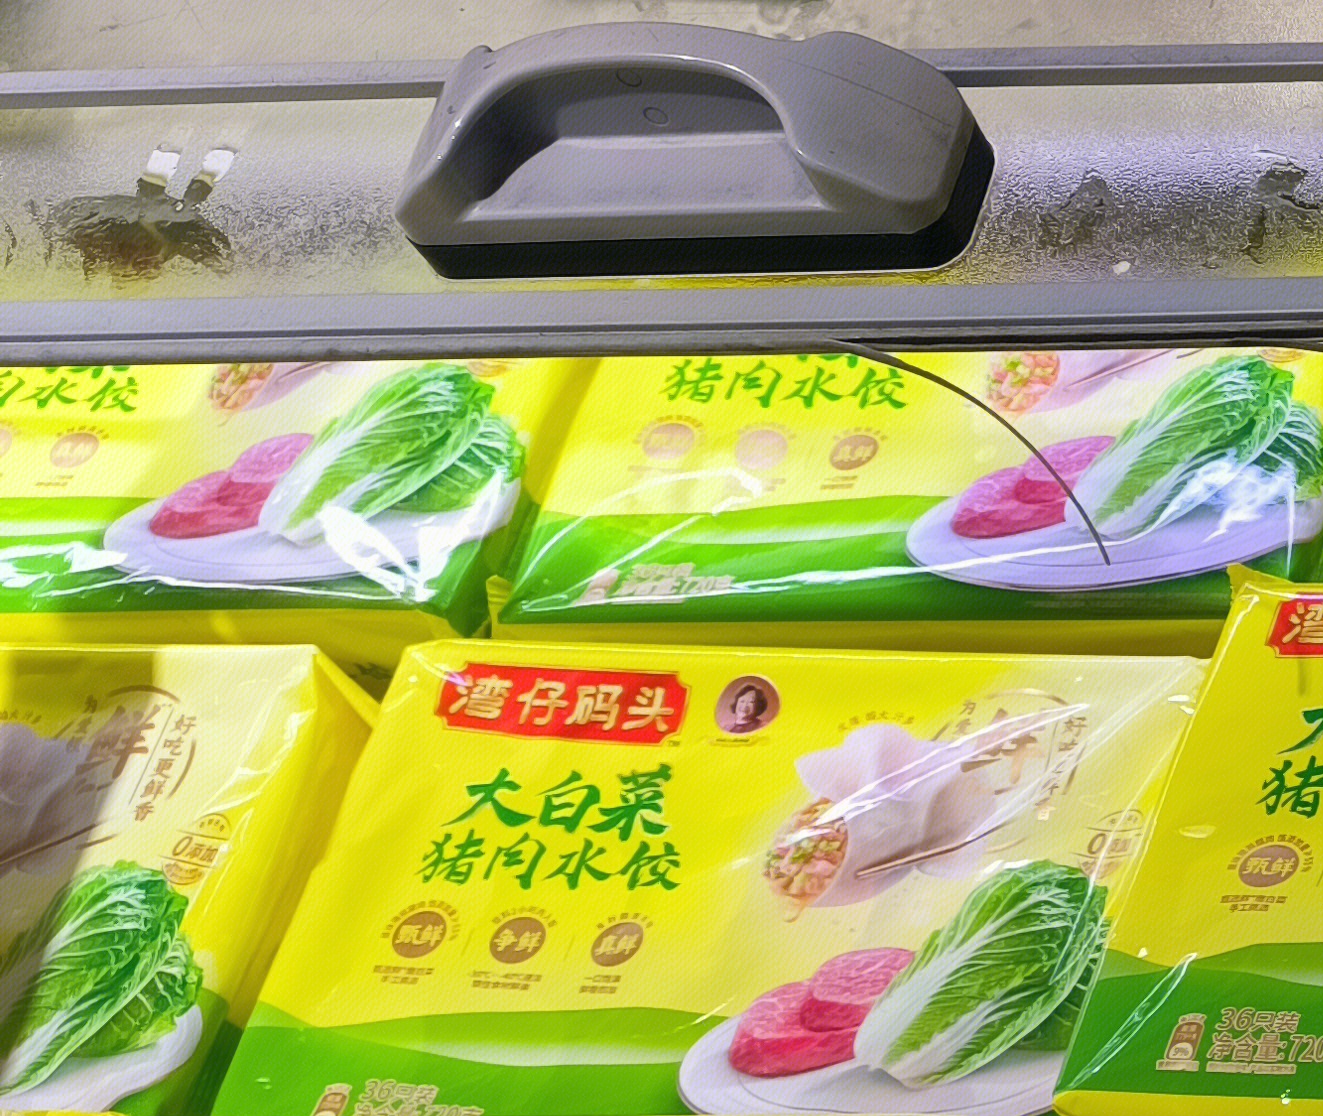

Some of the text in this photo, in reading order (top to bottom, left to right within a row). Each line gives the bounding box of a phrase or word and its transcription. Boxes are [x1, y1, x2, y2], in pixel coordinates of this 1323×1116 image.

[660, 357, 909, 409] 猪肉水饺
[447, 673, 678, 734] 湾仔码头
[133, 714, 198, 822] 好吃更鲜香
[440, 763, 674, 843] 大白菜
[414, 828, 683, 892] 猪肉水饺
[1241, 856, 1295, 876] 甄鲜
[1215, 1007, 1301, 1034] 36只装
